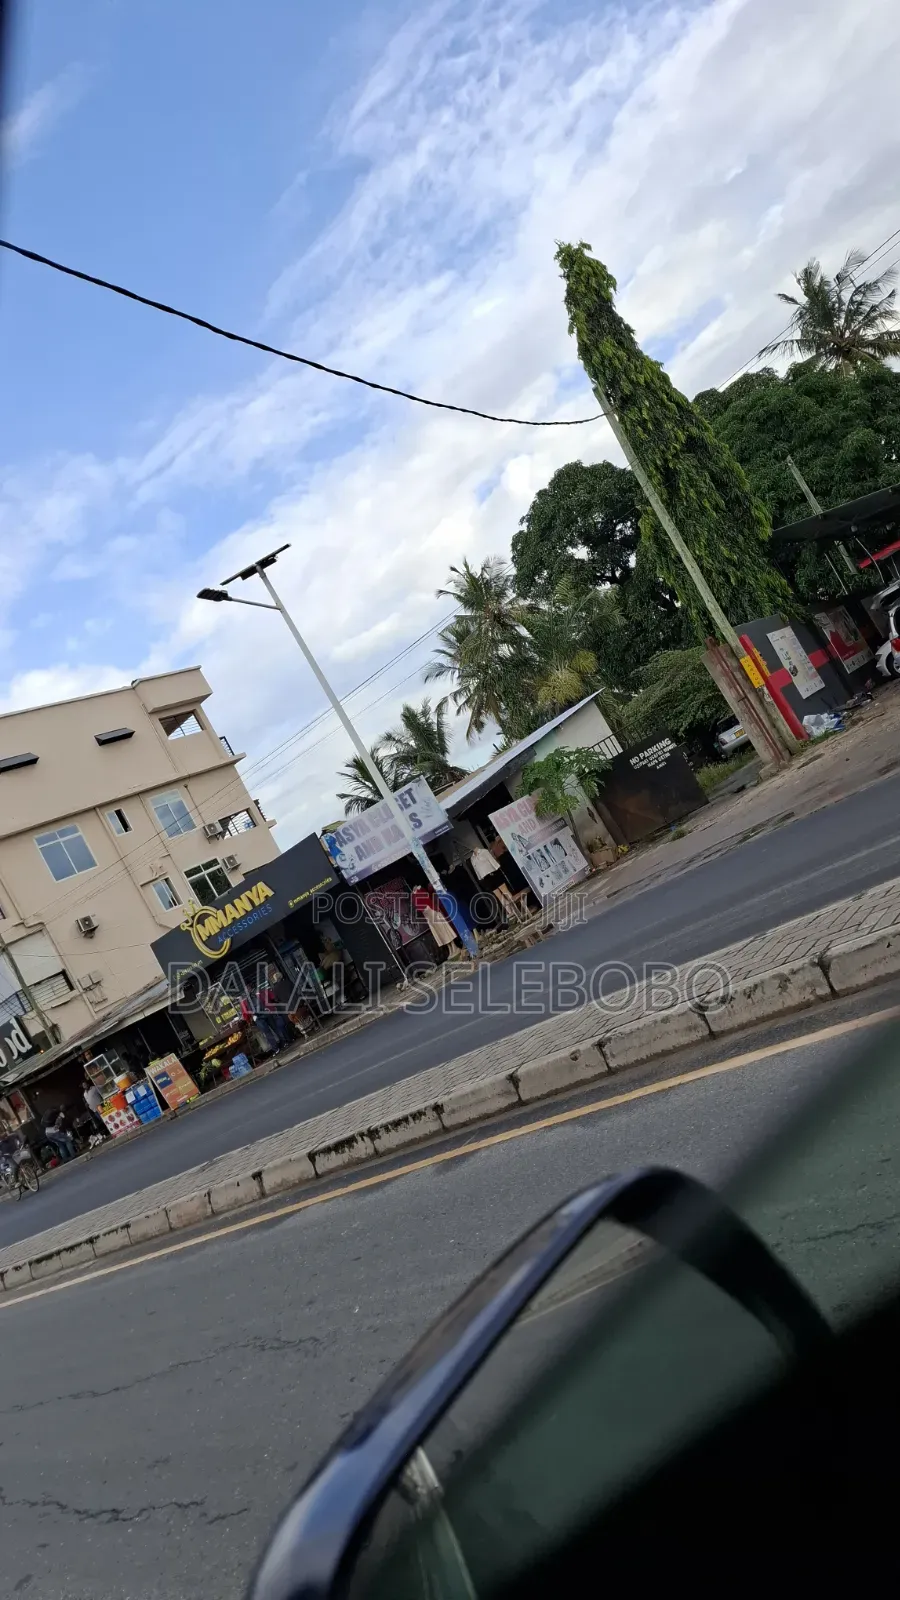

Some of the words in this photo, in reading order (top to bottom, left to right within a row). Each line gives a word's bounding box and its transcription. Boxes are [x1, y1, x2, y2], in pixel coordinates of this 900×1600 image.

[629, 756, 639, 766] NO
[639, 738, 671, 759] PARKING
[492, 805, 521, 831] ASYA
[516, 816, 538, 836] AND
[336, 818, 369, 847] ASYA
[354, 834, 385, 861] AND
[196, 881, 275, 941] MMANYA
[217, 903, 273, 945] ACCESSORIES
[149, 1056, 176, 1074] WAKALA
